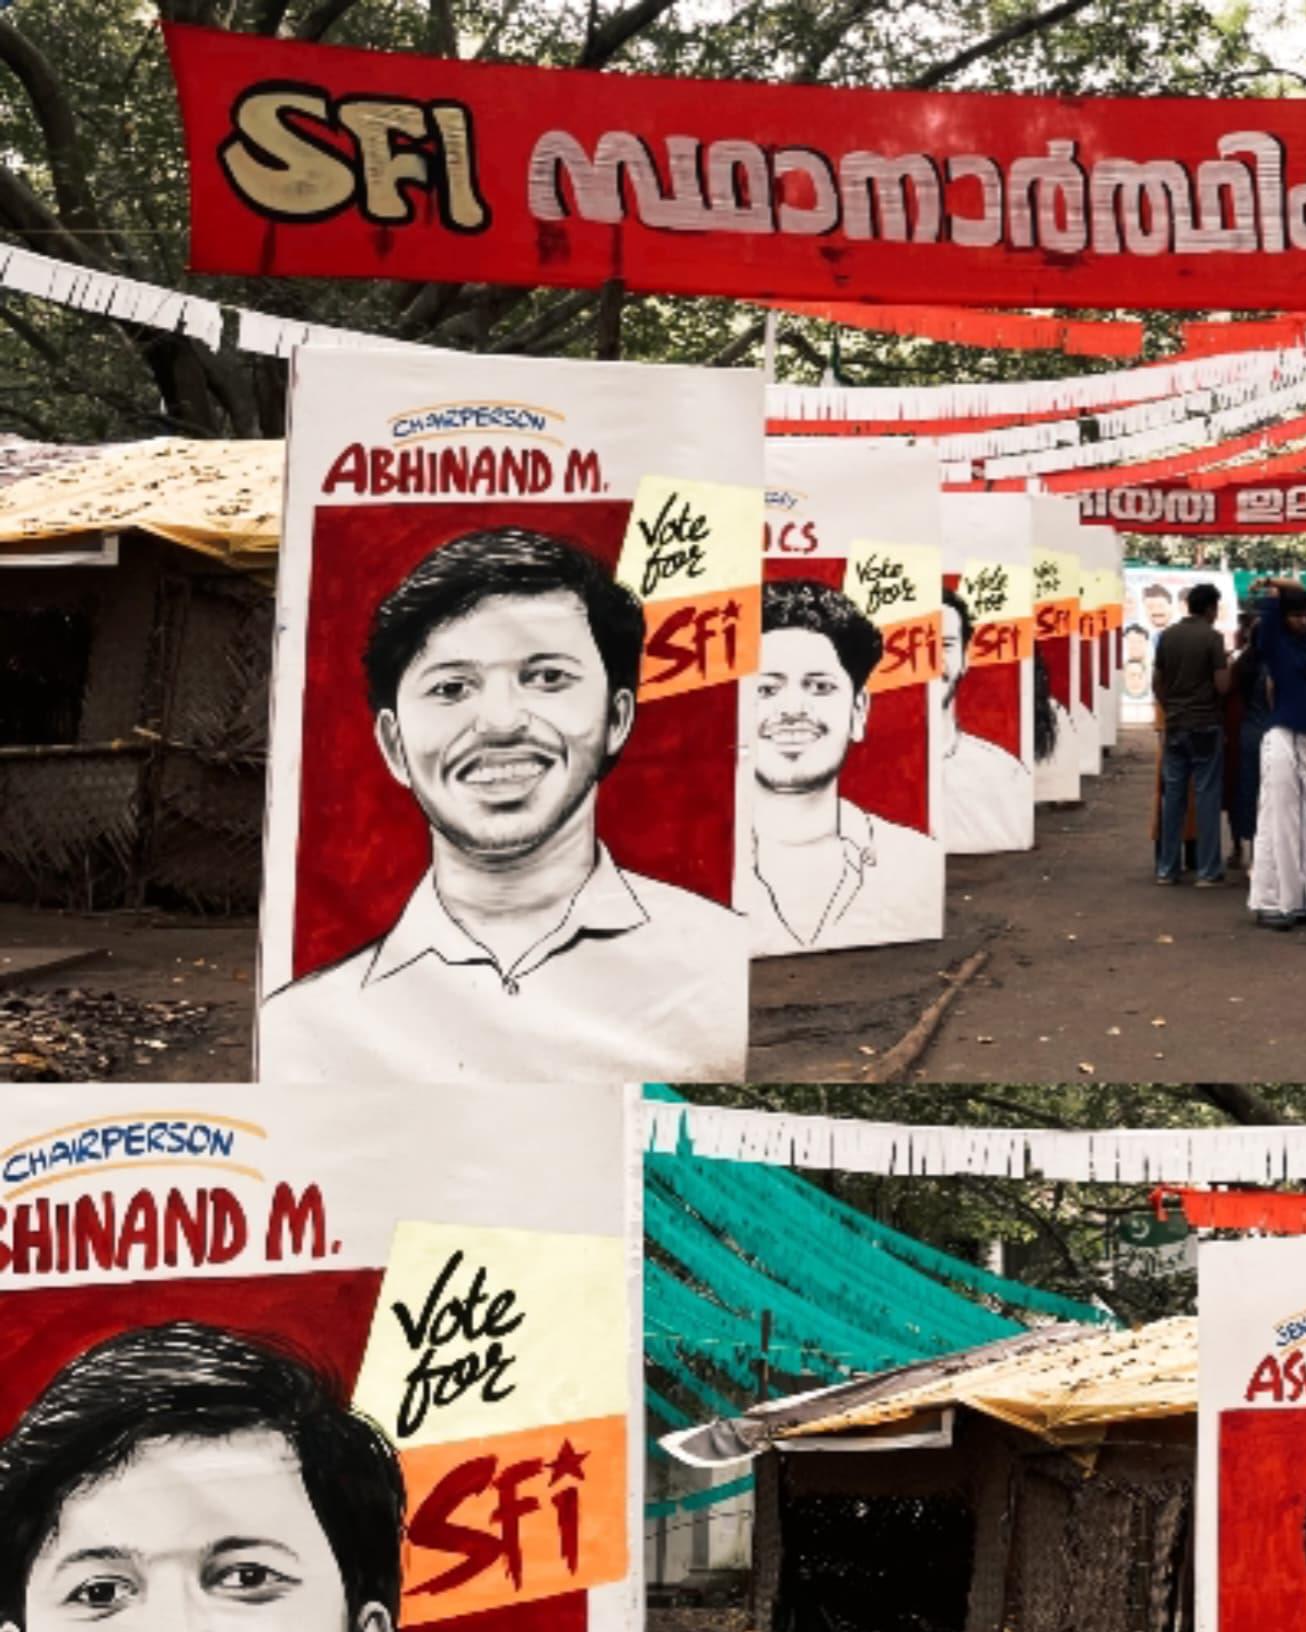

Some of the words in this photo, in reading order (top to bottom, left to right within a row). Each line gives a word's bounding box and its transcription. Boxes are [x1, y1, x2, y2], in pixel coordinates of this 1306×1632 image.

[216, 79, 491, 235] SFI
[321, 443, 553, 495] ABHINAND
[564, 447, 609, 494] M.
[638, 492, 710, 548] Vote
[2, 1122, 236, 1183] CHAIRPERSON
[265, 1181, 342, 1262] M.
[391, 1250, 526, 1350] Vote
[396, 1343, 517, 1438] for
